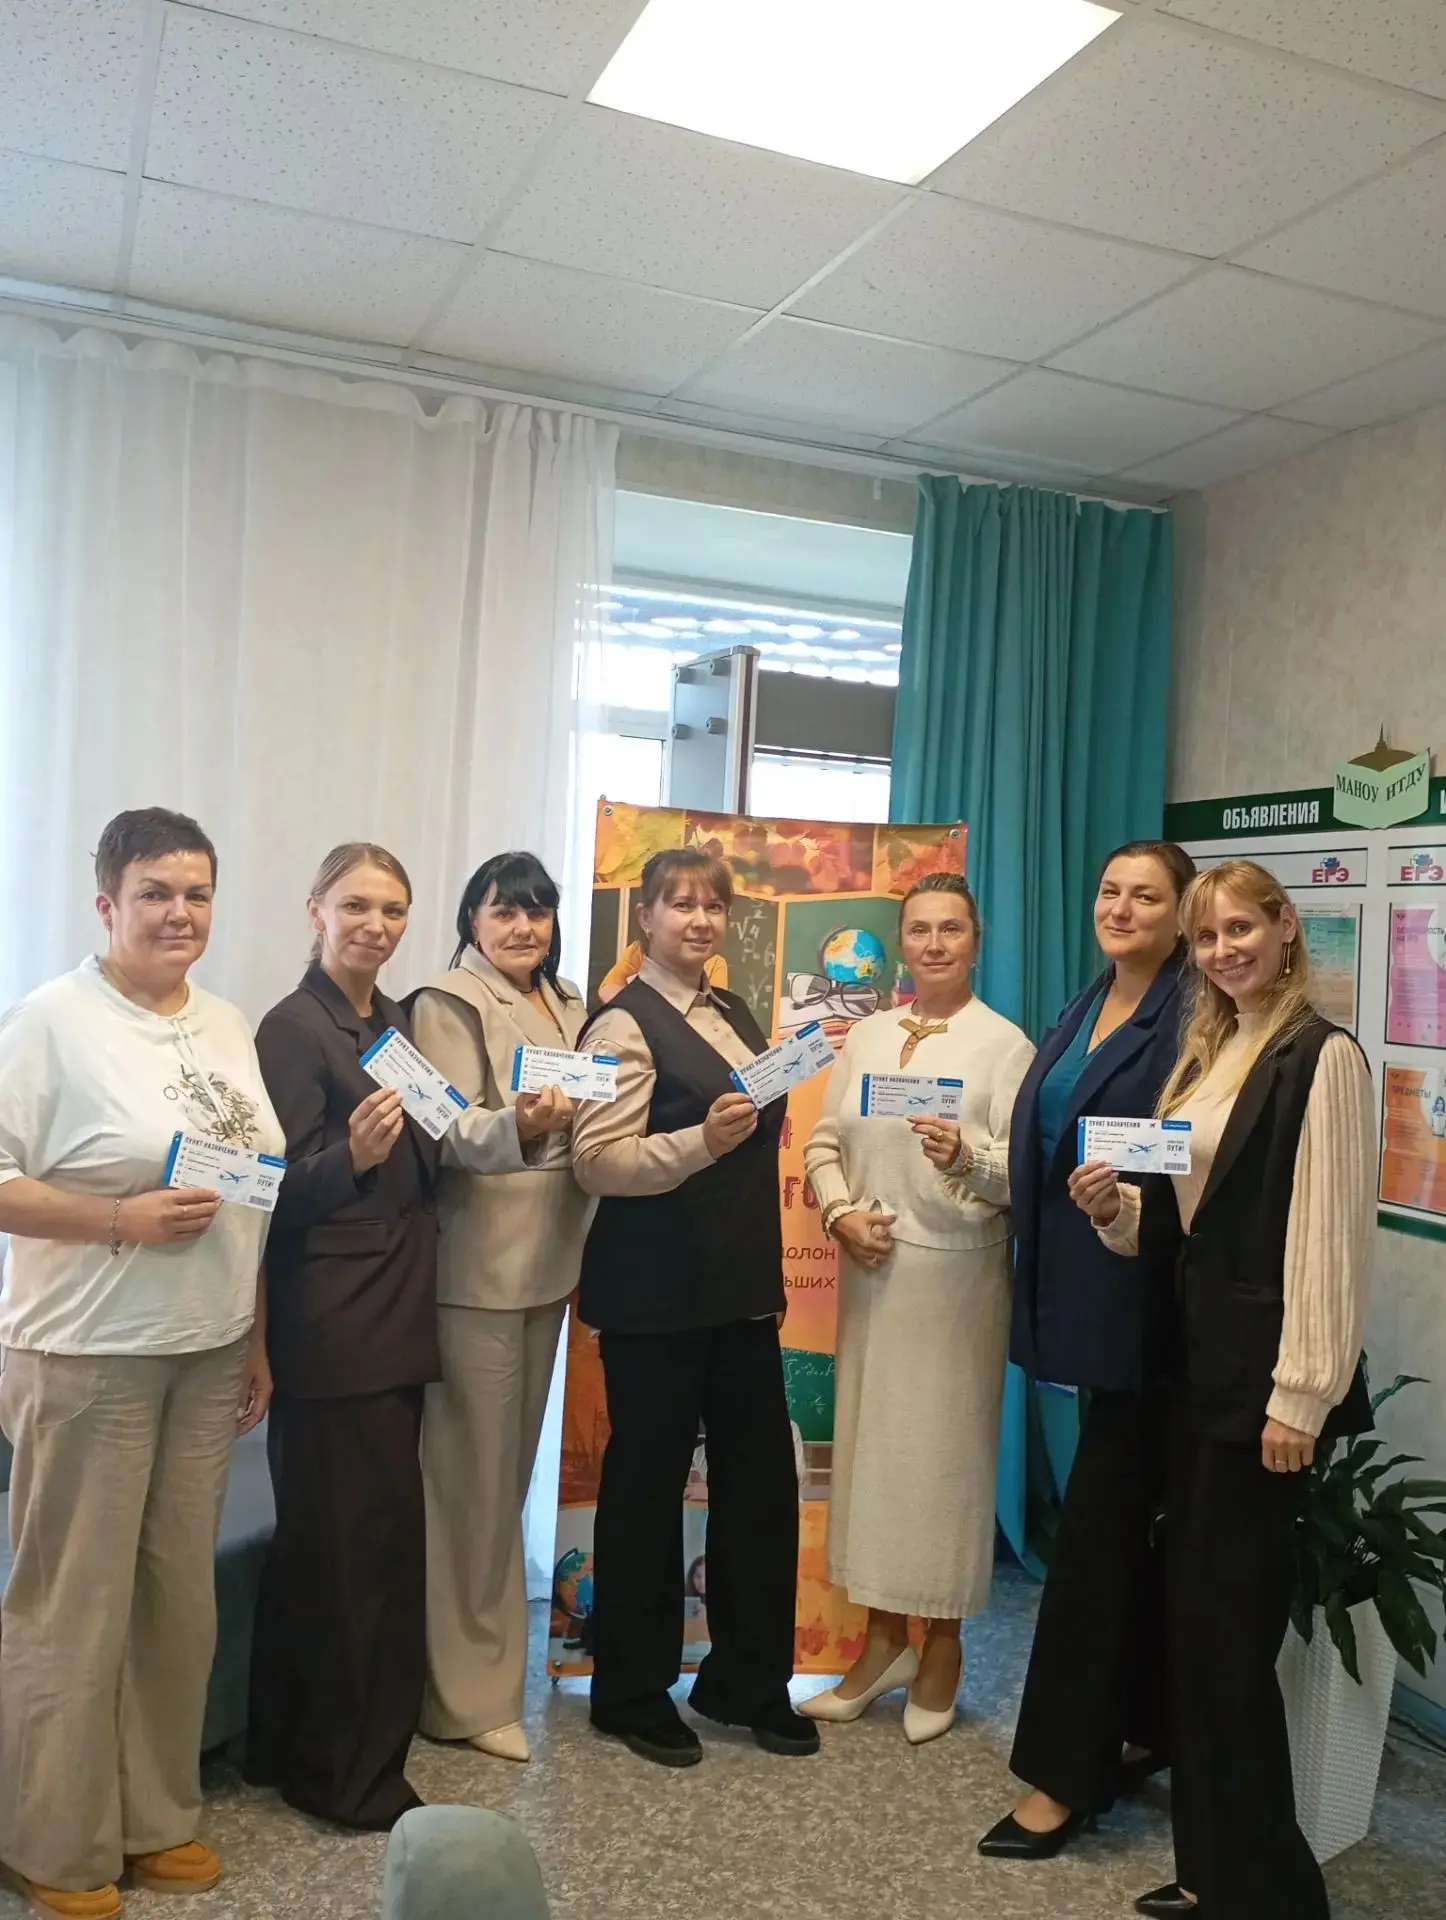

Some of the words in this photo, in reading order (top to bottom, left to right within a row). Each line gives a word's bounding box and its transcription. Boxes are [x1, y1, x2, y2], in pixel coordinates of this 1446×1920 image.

[1336, 773, 1379, 803] МАНОУ
[1386, 763, 1426, 801] НТДУ
[1222, 800, 1320, 830] ОБЪЯВЛЕНИЯ
